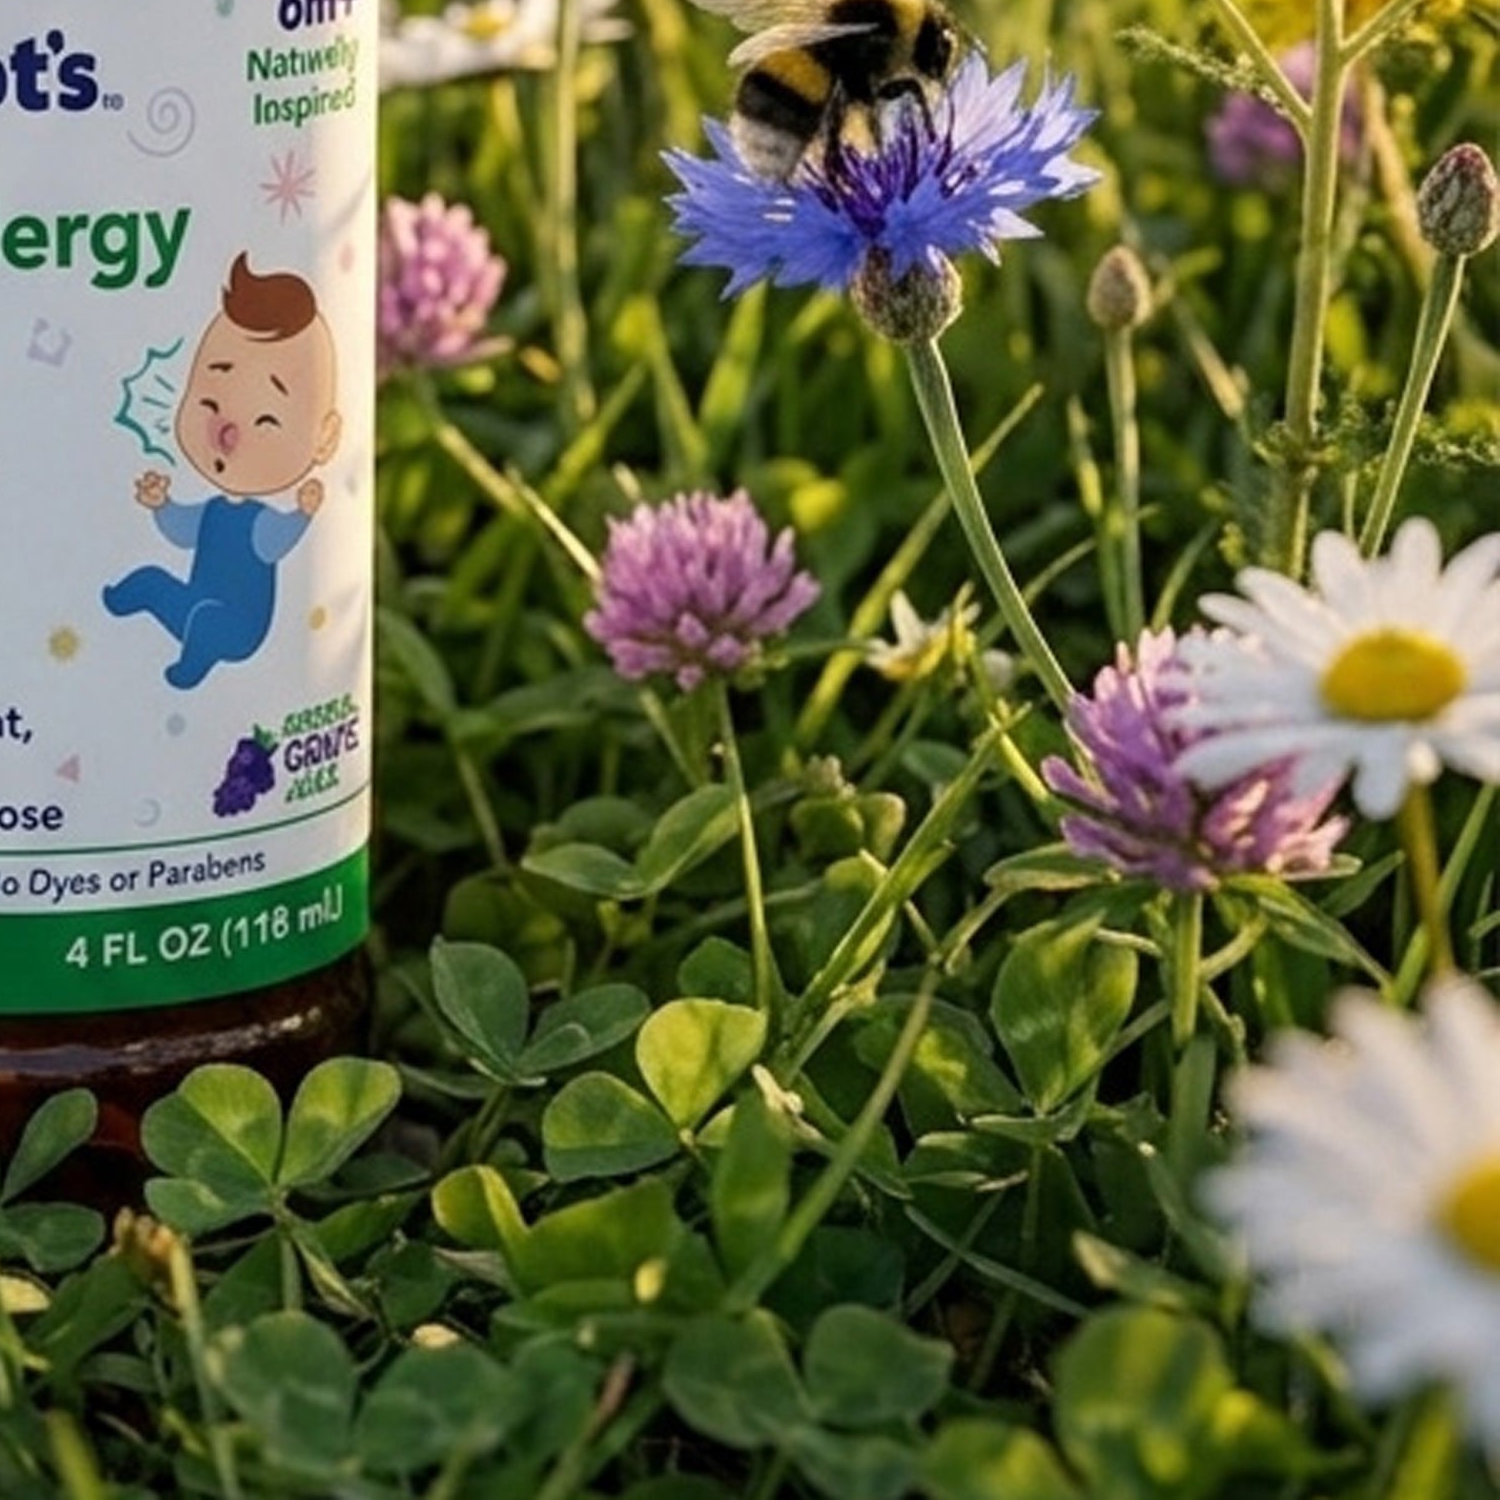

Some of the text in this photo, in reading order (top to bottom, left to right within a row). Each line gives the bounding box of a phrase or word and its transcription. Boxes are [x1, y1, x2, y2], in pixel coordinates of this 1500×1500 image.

[29, 868, 101, 905] Dyes
[109, 869, 140, 892] or
[149, 851, 267, 889] Parabens
[65, 935, 89, 969] 4
[102, 931, 148, 967] FL
